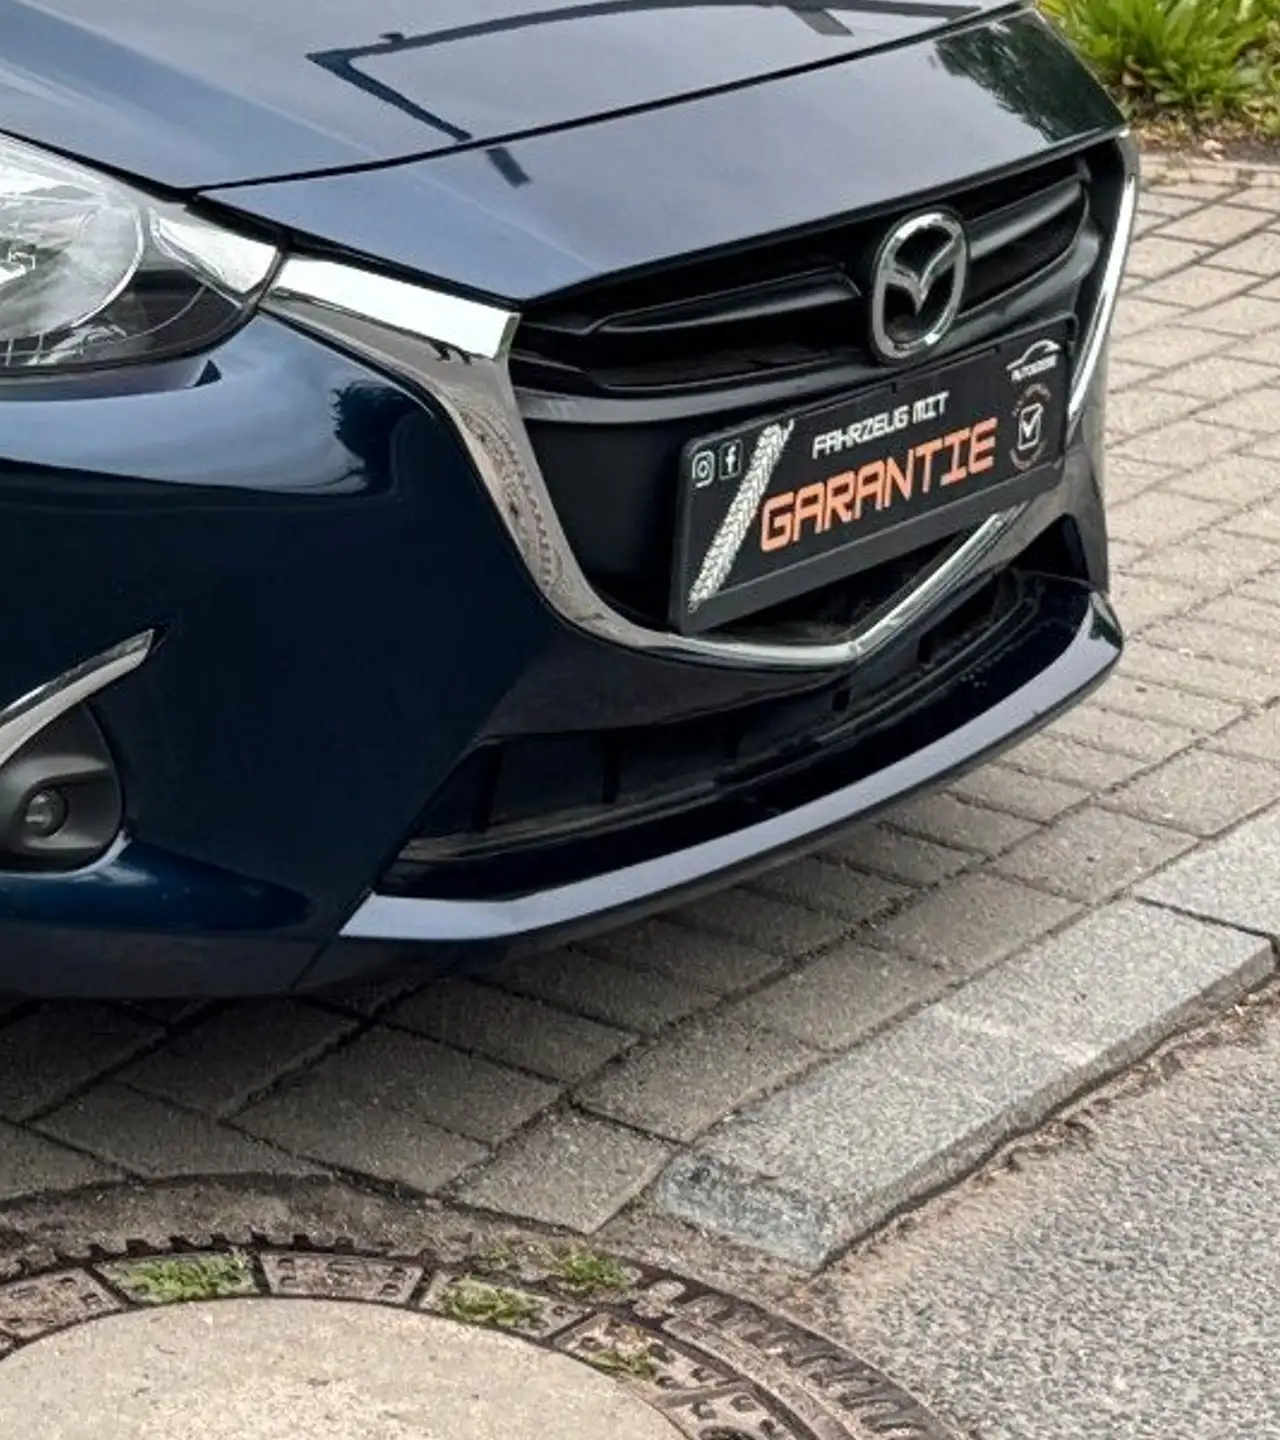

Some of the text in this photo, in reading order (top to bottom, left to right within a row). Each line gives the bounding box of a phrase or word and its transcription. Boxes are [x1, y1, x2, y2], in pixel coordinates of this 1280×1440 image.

[812, 391, 950, 460] FAHRZEUG MIT
[759, 416, 999, 553] GARANTIE
